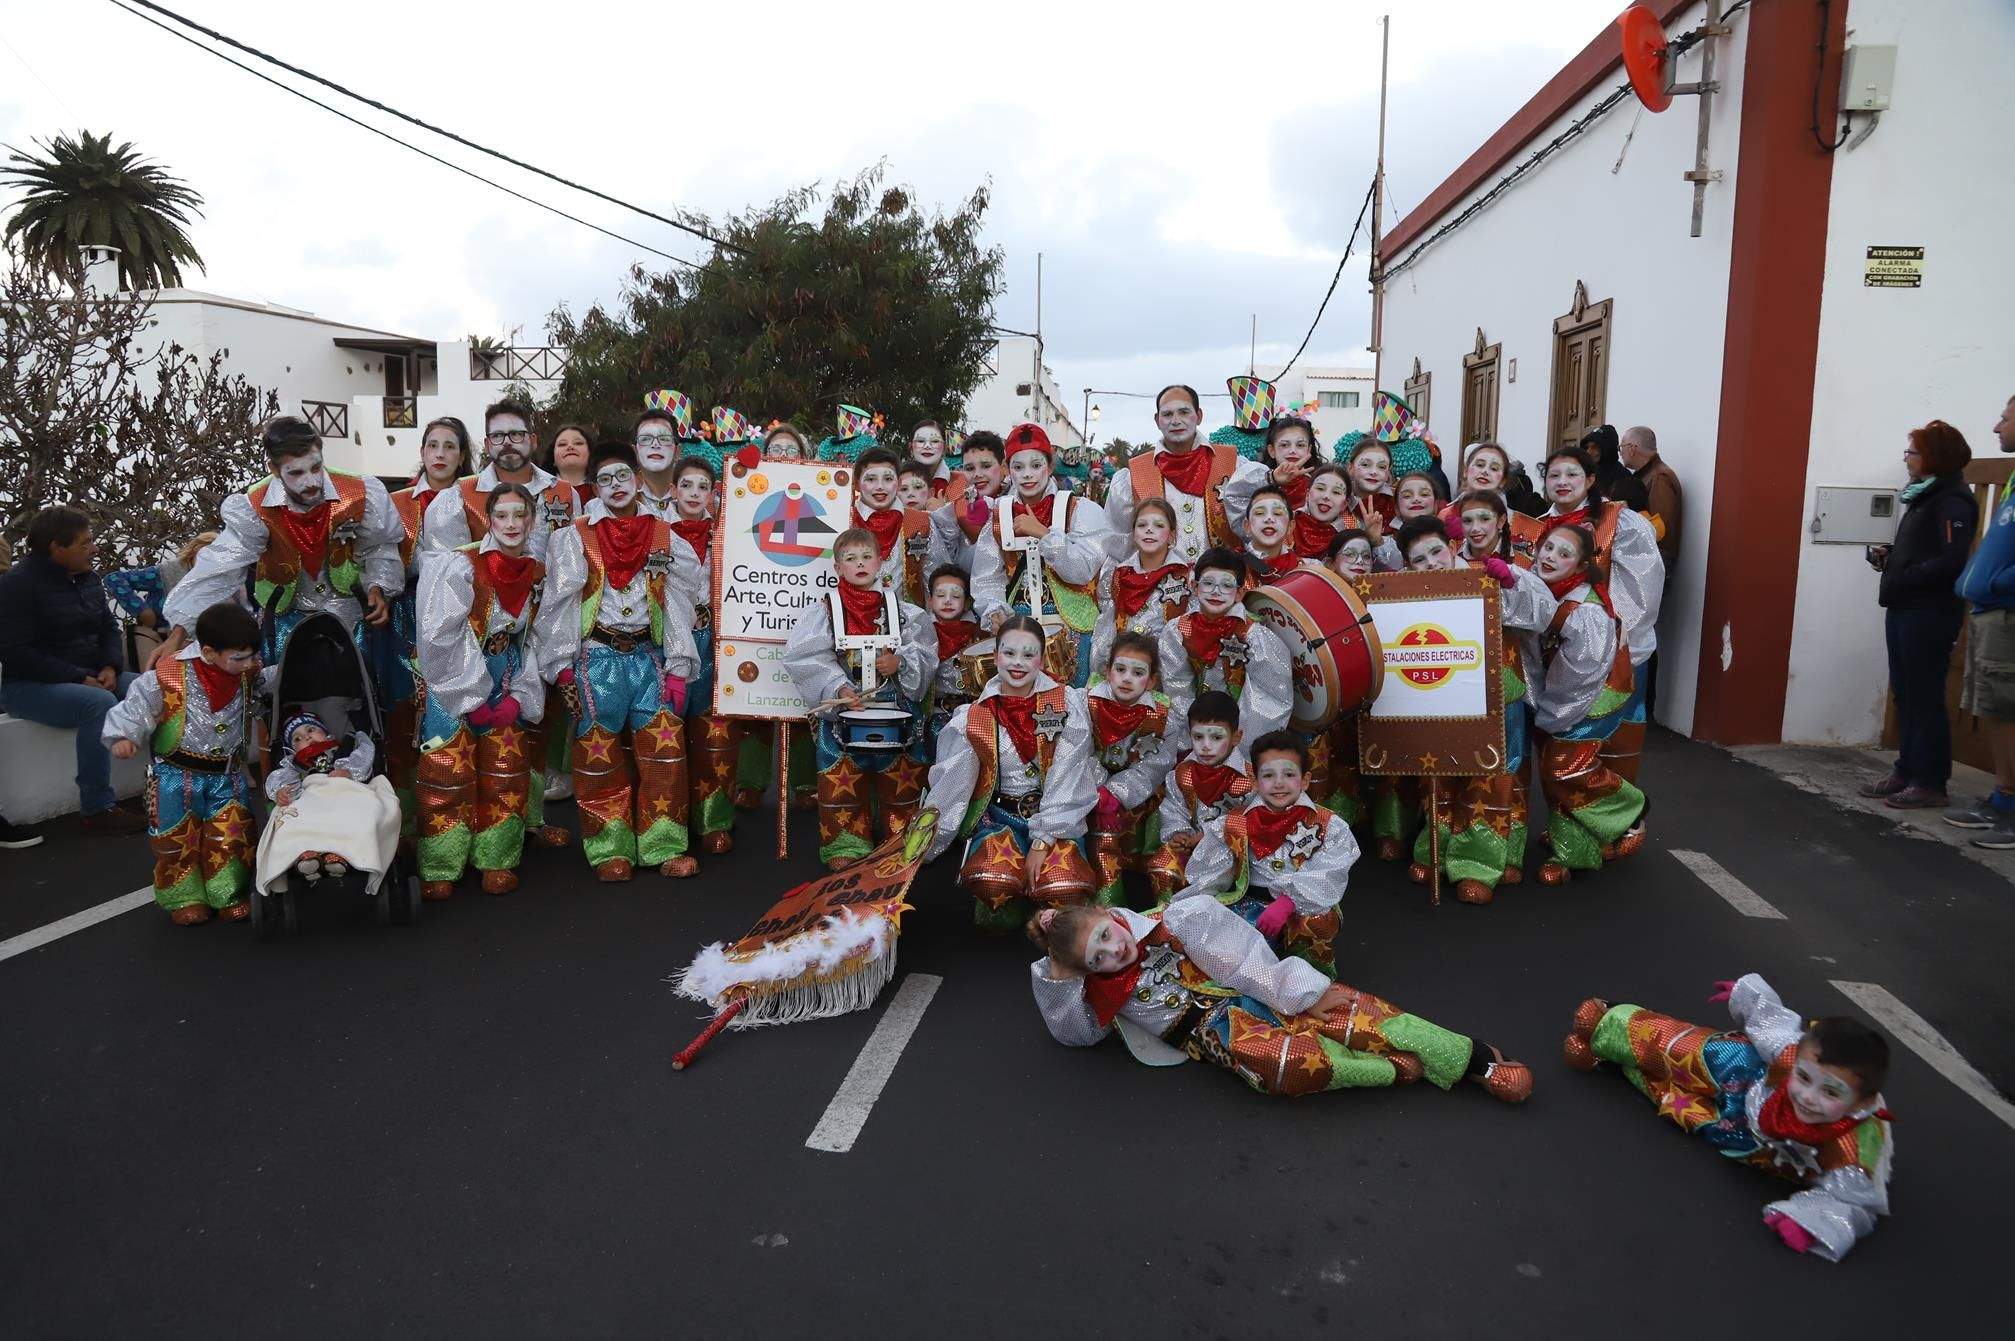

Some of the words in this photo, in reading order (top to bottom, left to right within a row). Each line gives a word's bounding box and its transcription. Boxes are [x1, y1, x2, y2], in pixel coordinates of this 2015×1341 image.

[1872, 249, 1915, 257] ATENCIÓN
[733, 564, 808, 586] Centros
[816, 570, 839, 588] de
[723, 585, 772, 607] Arte,
[774, 590, 817, 608] Cult
[742, 616, 752, 633] y
[1431, 650, 1475, 662] ELECTRICAS
[772, 670, 789, 683] de
